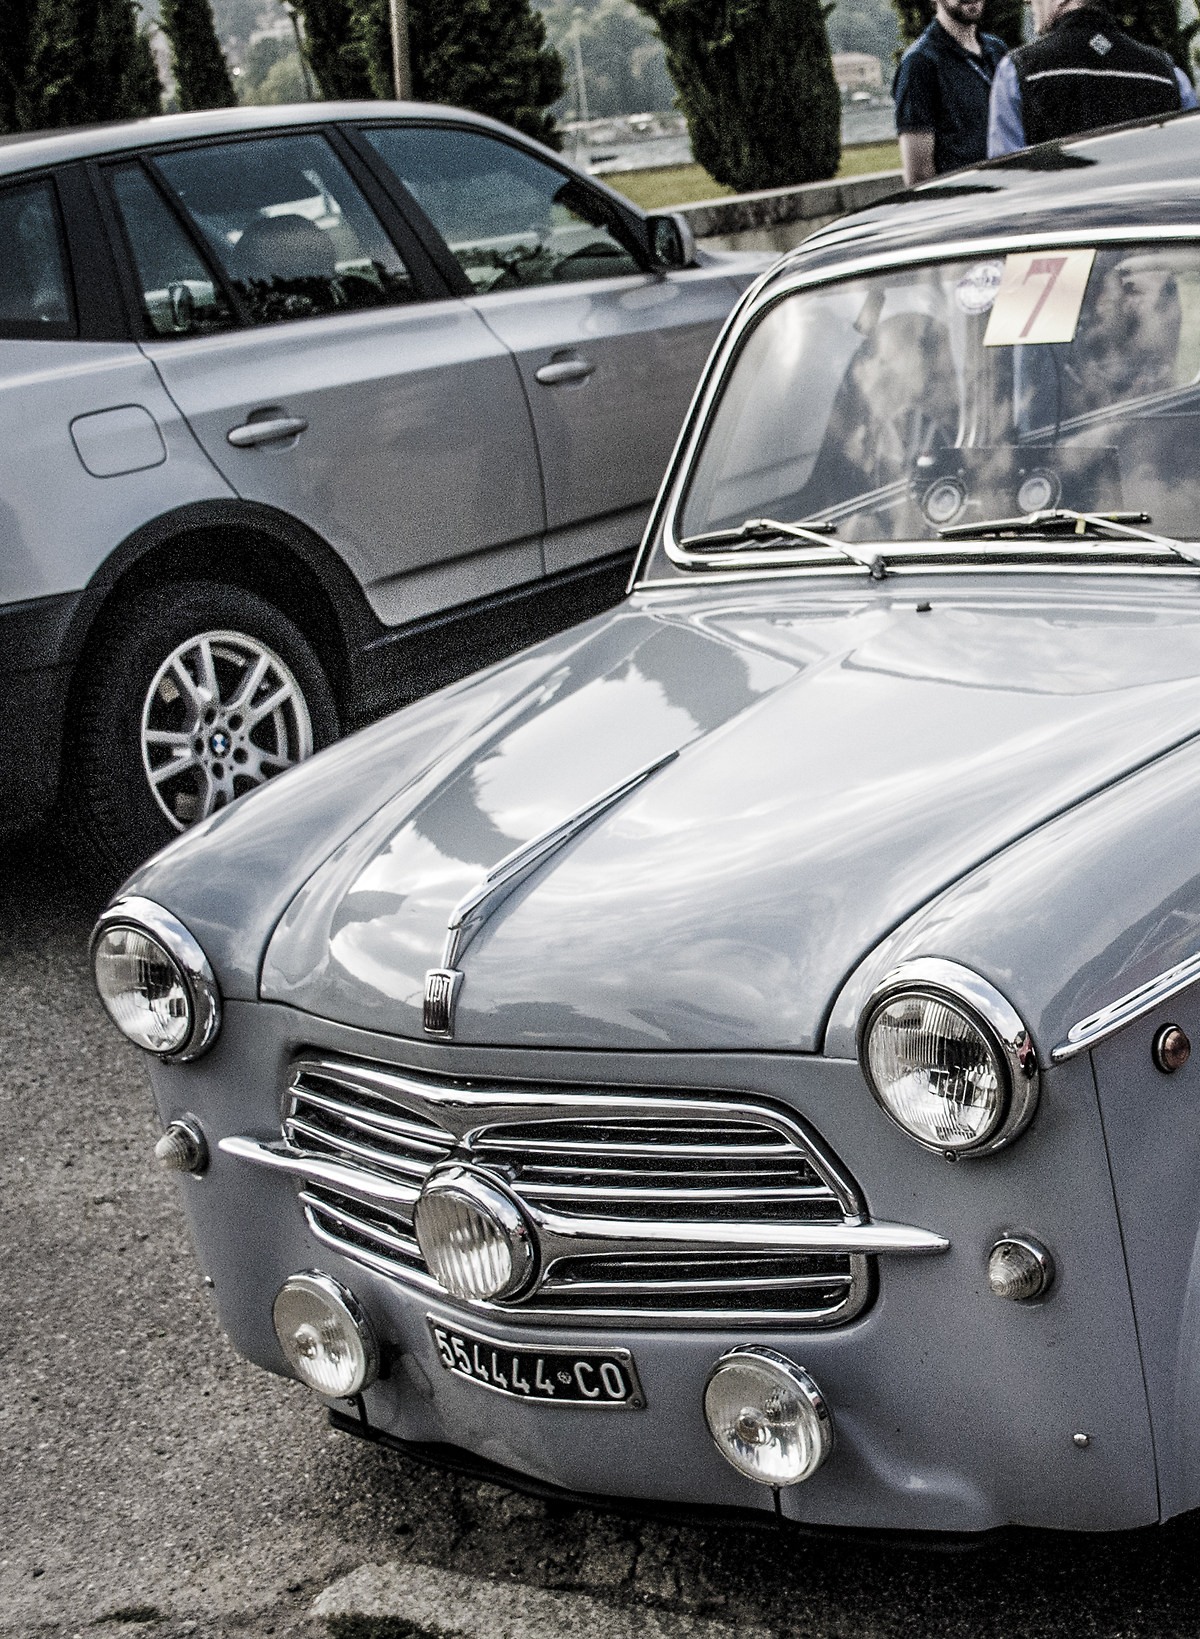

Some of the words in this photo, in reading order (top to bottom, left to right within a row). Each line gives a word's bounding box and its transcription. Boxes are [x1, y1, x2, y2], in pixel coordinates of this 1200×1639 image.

[1022, 257, 1068, 338] 7
[434, 1328, 555, 1395] 554444
[574, 1361, 626, 1399] CO
